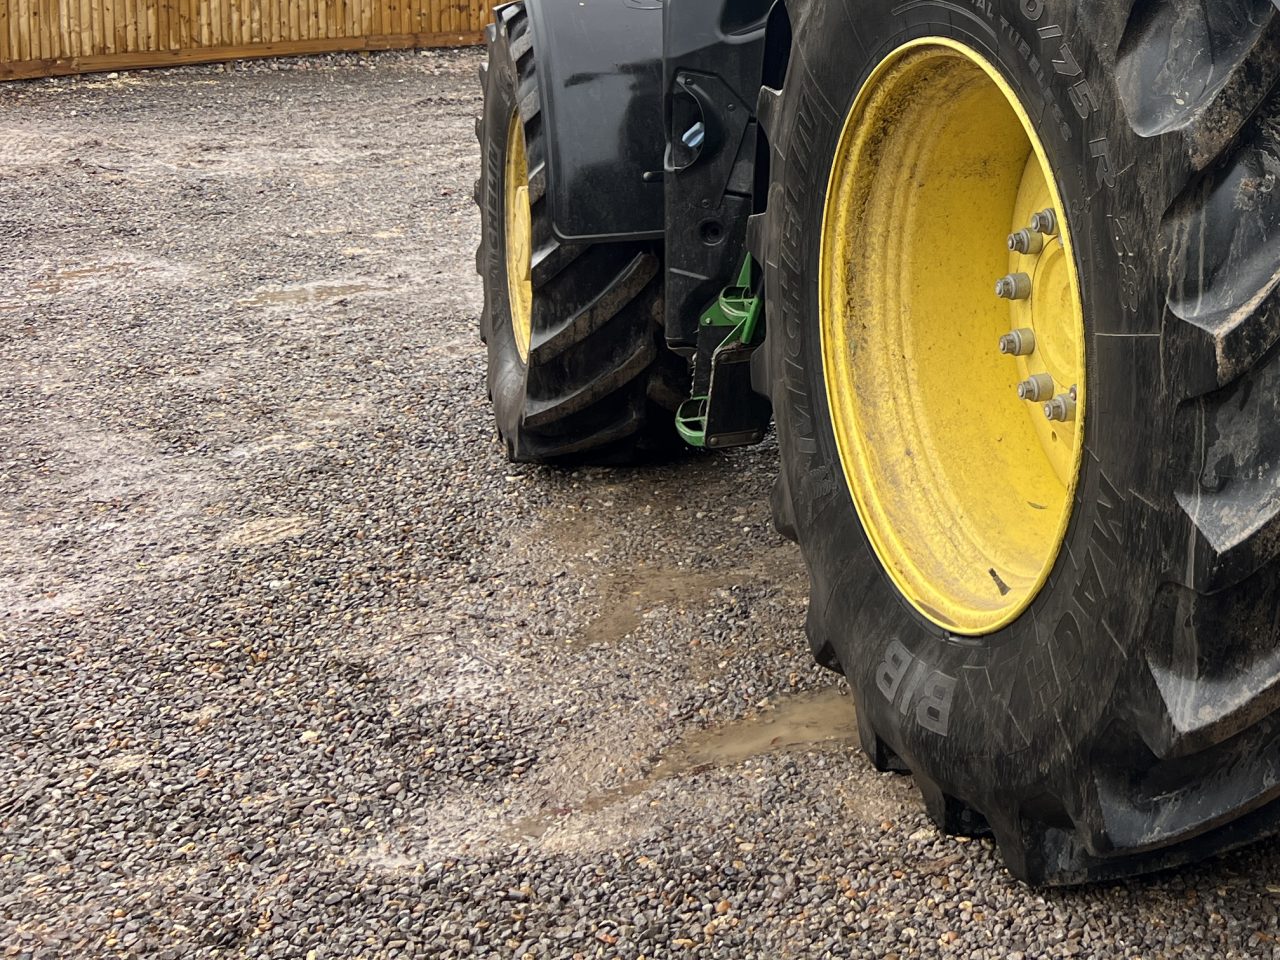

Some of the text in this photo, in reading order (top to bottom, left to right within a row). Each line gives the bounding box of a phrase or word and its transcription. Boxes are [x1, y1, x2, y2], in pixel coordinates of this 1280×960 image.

[1000, 16, 1073, 142] TUBELESS
[1088, 137, 1116, 188] R
[781, 81, 832, 453] MICHELIN
